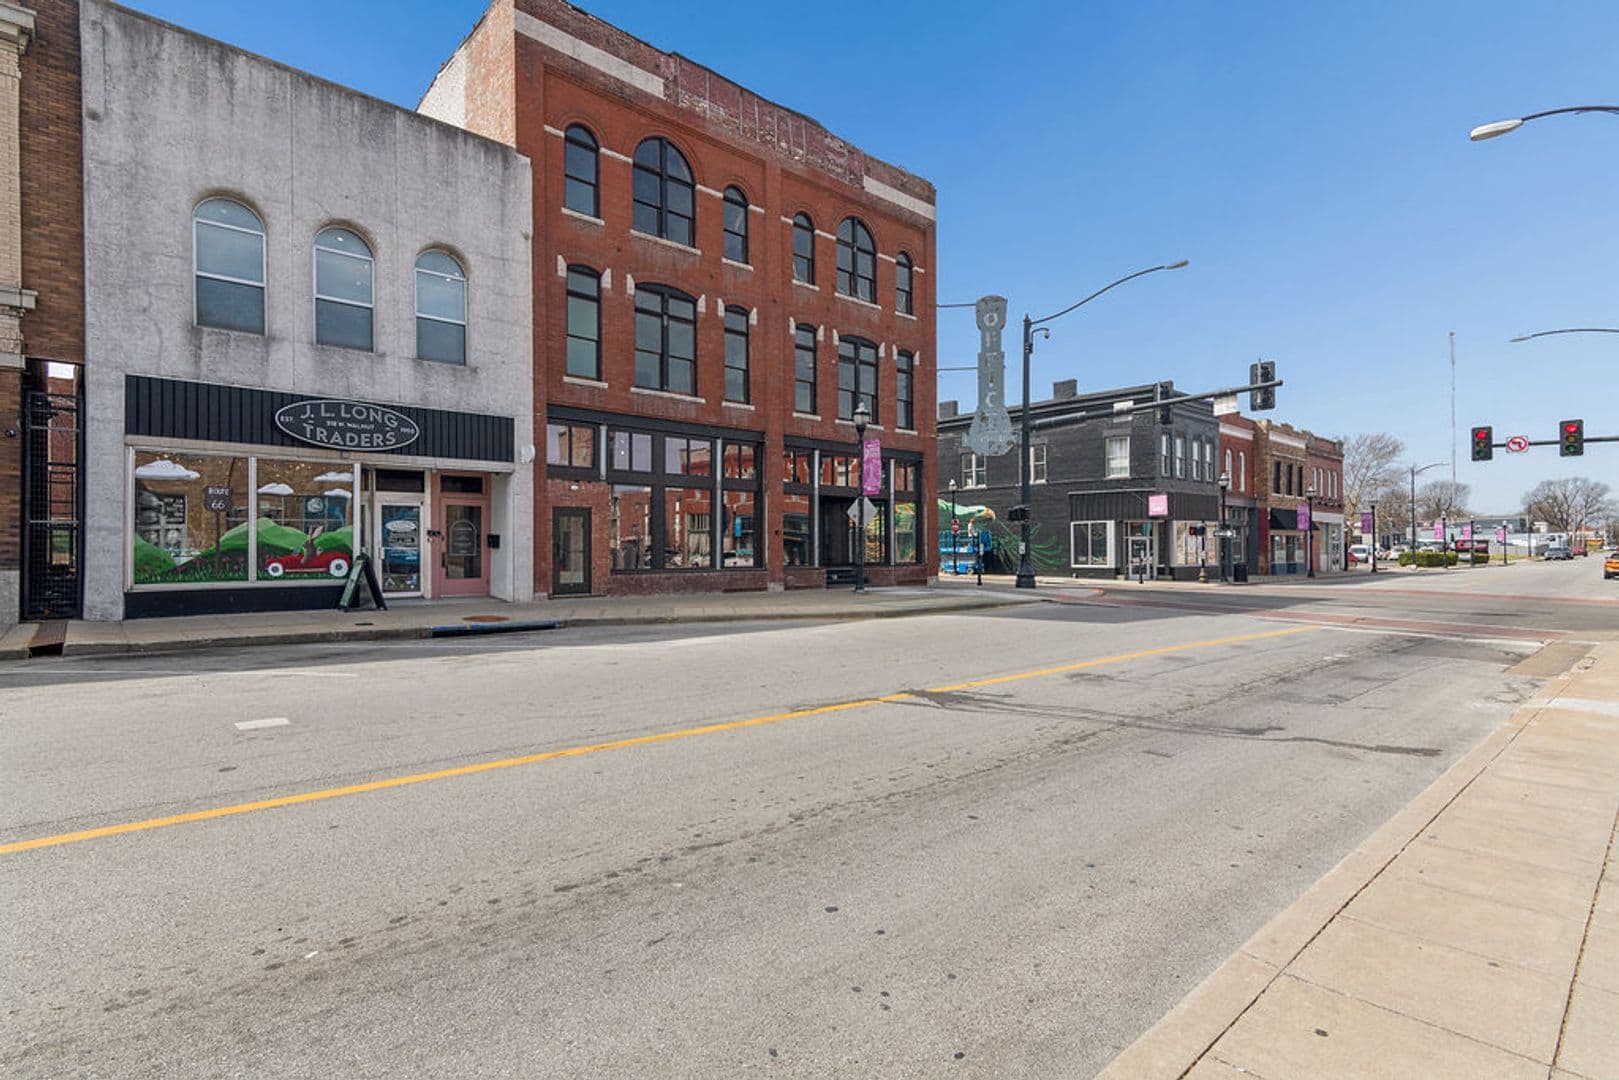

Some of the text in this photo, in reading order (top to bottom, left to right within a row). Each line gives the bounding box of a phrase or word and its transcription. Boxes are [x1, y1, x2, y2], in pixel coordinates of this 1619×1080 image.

[300, 403, 398, 428] J. L. LONG
[302, 422, 396, 447] TRADERS
[211, 500, 226, 509] 66
